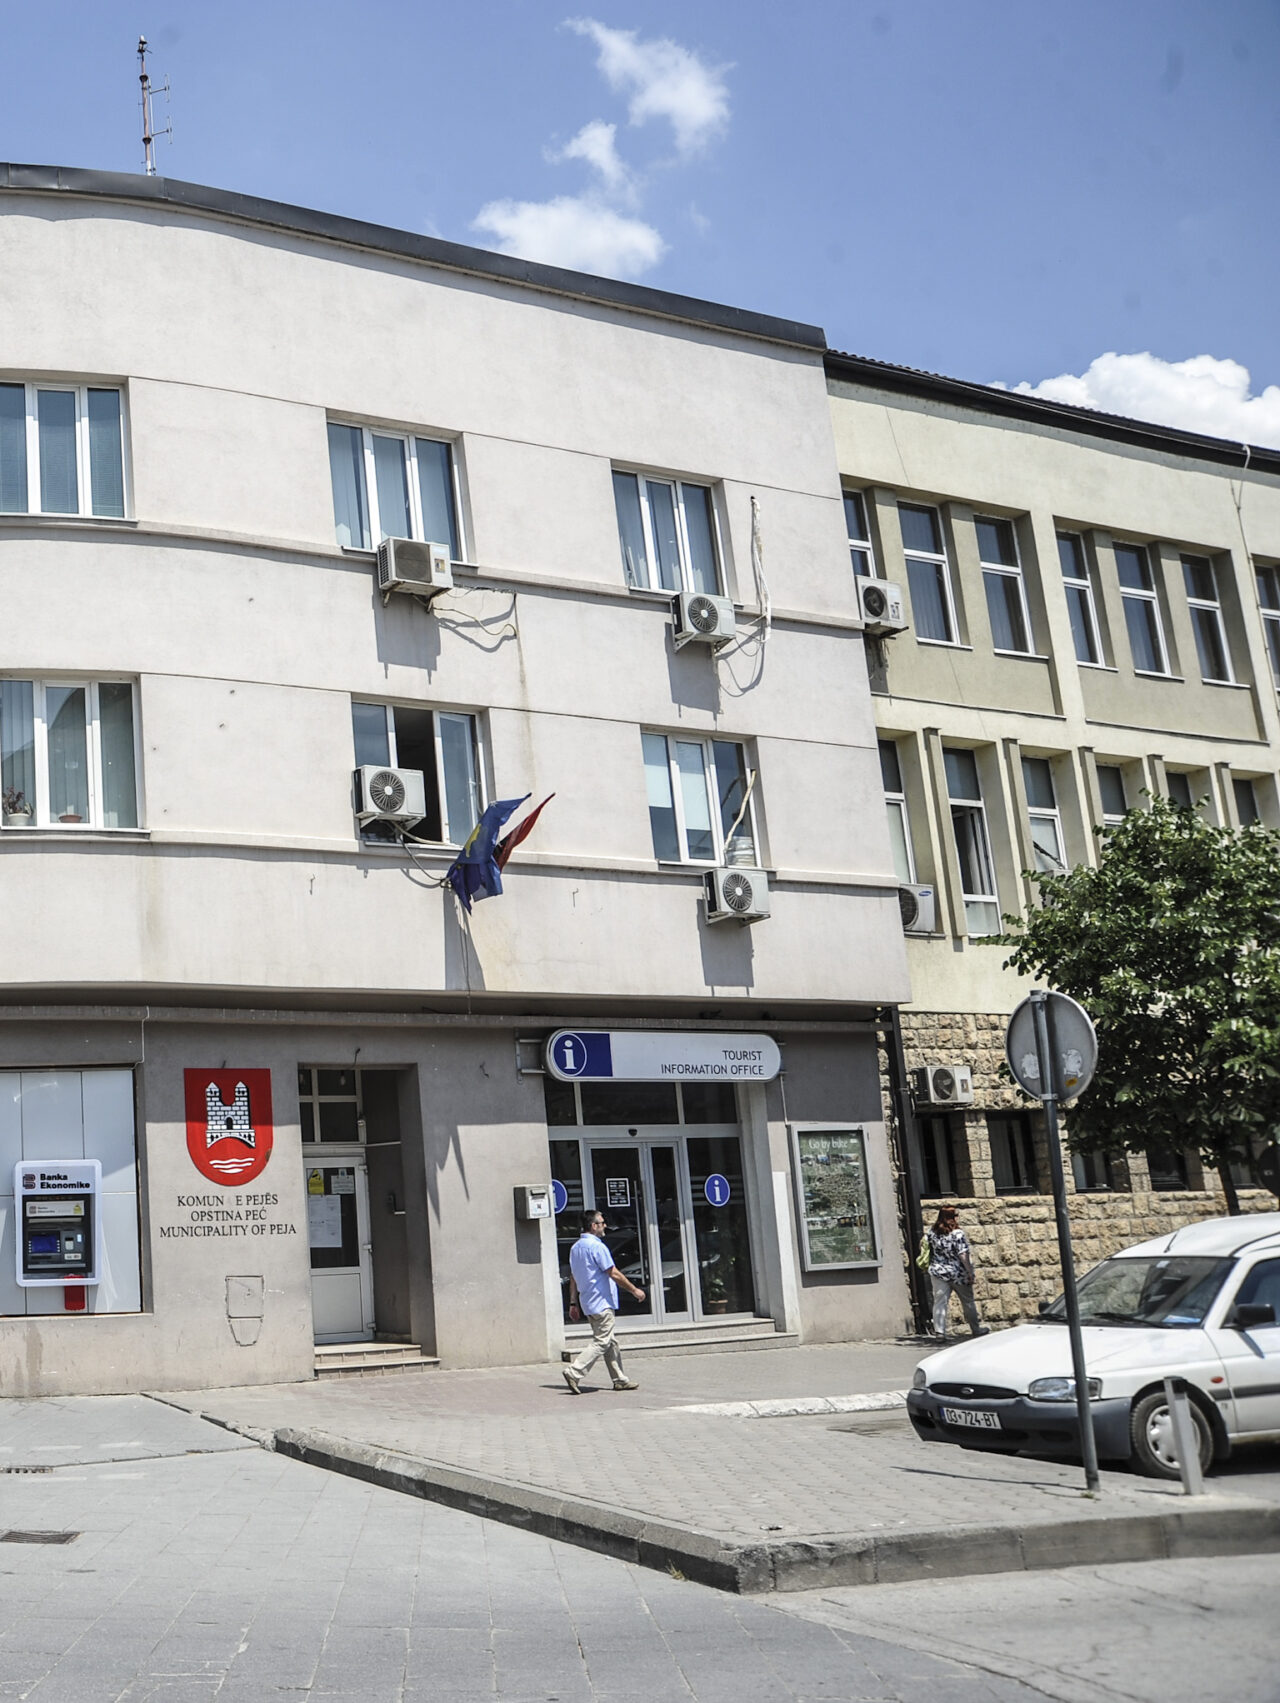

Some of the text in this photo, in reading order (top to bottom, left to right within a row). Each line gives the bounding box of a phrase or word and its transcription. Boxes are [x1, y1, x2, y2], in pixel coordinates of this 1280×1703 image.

[722, 1050, 762, 1061] TOURIST
[661, 1064, 764, 1075] INFORMATION OFFICE
[40, 1173, 68, 1181] Banka
[40, 1181, 90, 1189] Ekonomike
[235, 1195, 243, 1206] E
[246, 1192, 278, 1206] PEJËS
[190, 1210, 243, 1222] OPSTINA
[160, 1224, 297, 1238] MUNICIPALITY OF PEJA
